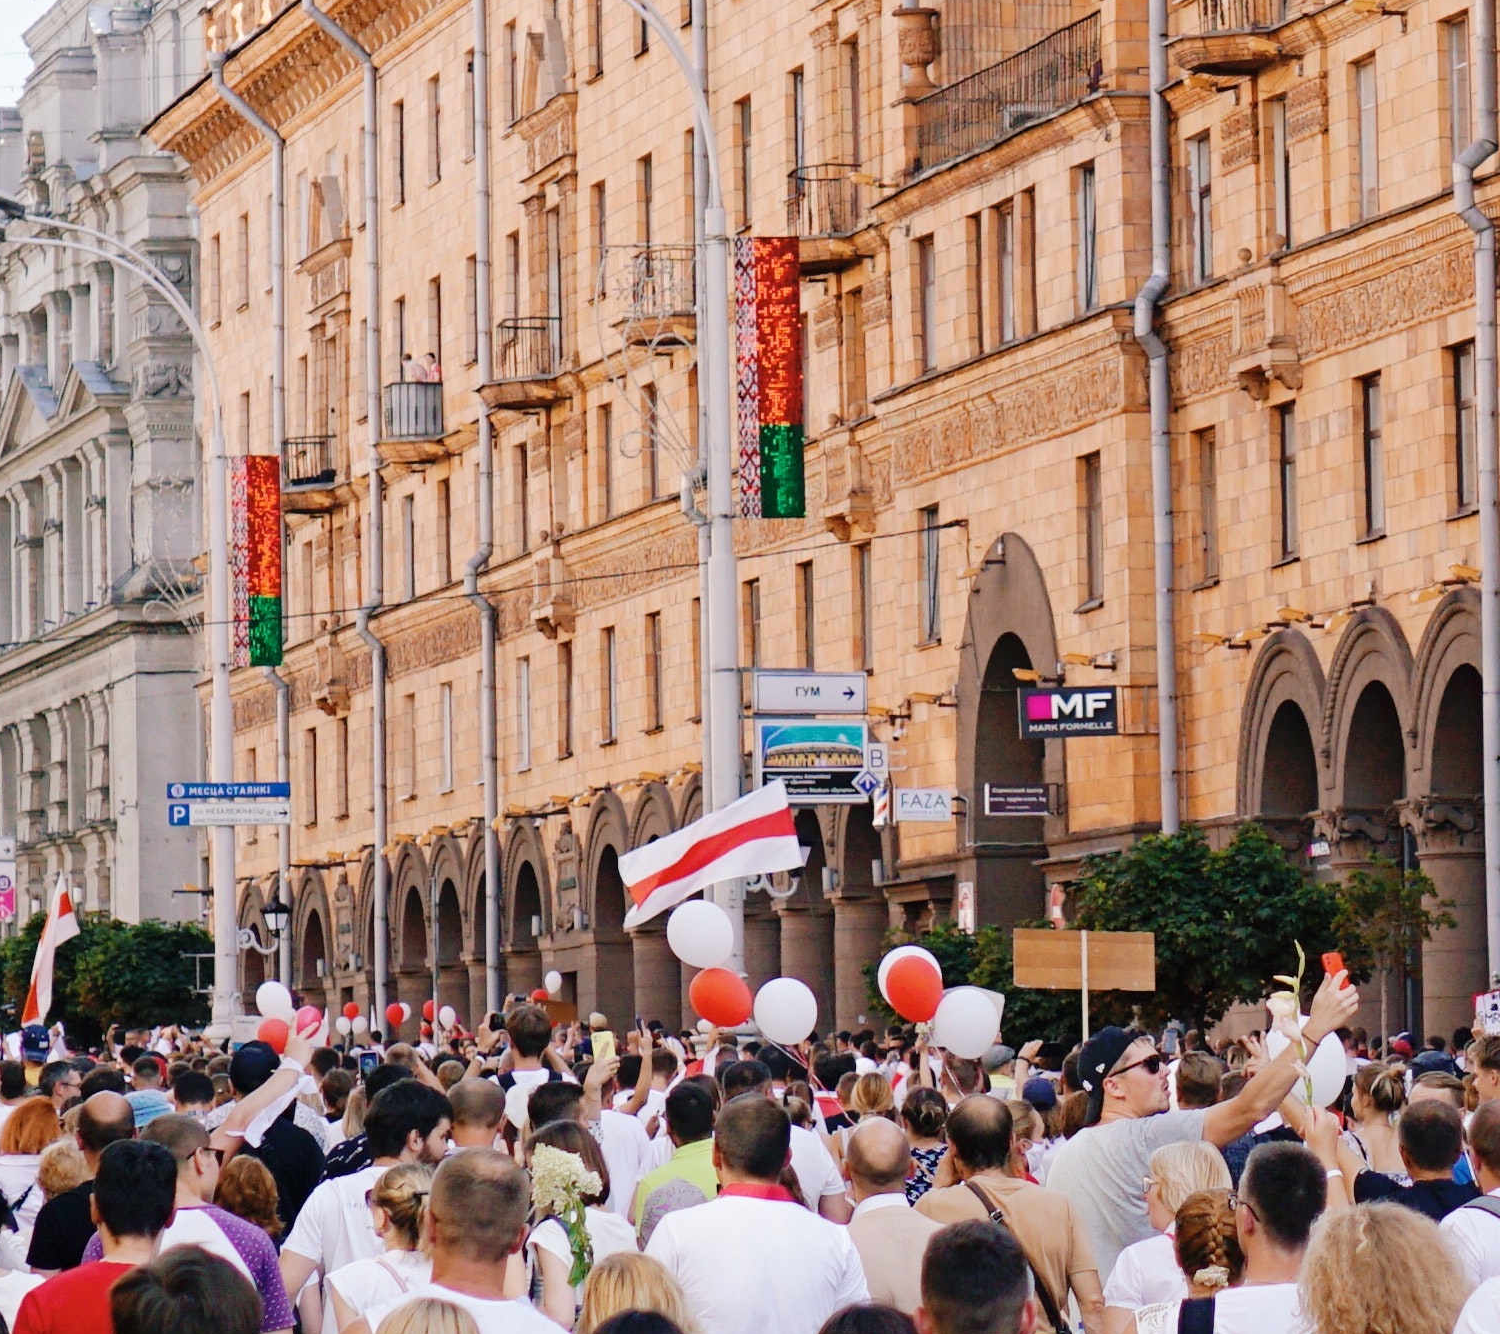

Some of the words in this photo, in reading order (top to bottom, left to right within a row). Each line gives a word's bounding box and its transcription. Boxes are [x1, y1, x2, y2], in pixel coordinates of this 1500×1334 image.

[795, 687, 820, 697] ГУМ
[1051, 692, 1112, 720] MF
[1029, 723, 1058, 732] MARK
[1059, 721, 1113, 731] FORMELLE
[188, 786, 224, 796] МЕСЦА
[901, 792, 947, 809] FAZA
